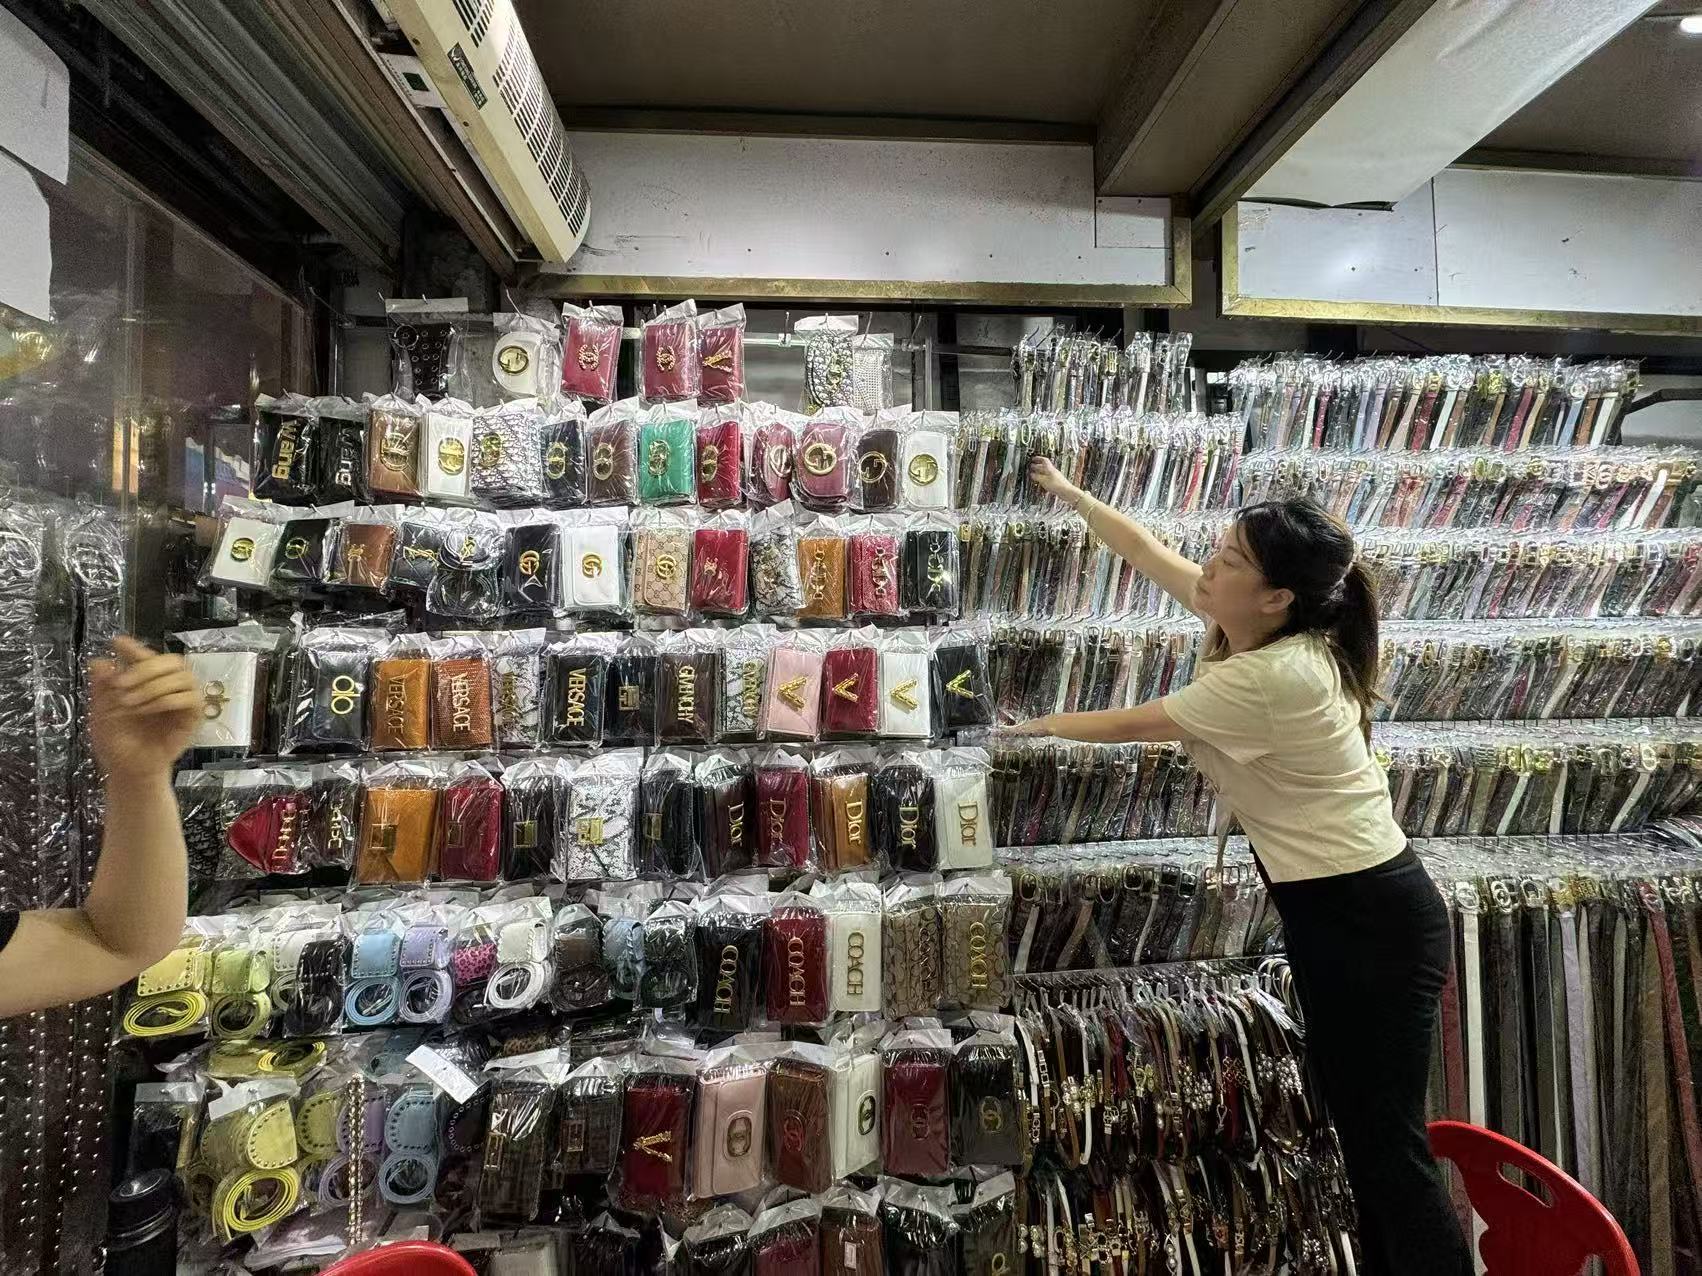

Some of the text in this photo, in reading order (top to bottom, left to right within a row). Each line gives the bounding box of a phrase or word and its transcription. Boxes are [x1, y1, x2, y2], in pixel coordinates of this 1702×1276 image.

[271, 419, 298, 480] wang
[387, 674, 404, 735] VERSACE
[451, 672, 471, 732] VERSACE
[567, 667, 587, 727] VERSACE
[677, 664, 696, 724] GIVENCHY
[728, 800, 745, 848] Dior
[769, 797, 788, 842] Dior
[845, 799, 864, 845] Dior
[898, 804, 920, 850] Dior
[958, 801, 980, 847] Dior
[713, 944, 739, 1015] COACH
[787, 936, 807, 1007] COACH
[846, 931, 865, 997] COACH
[969, 920, 989, 989] COACH
